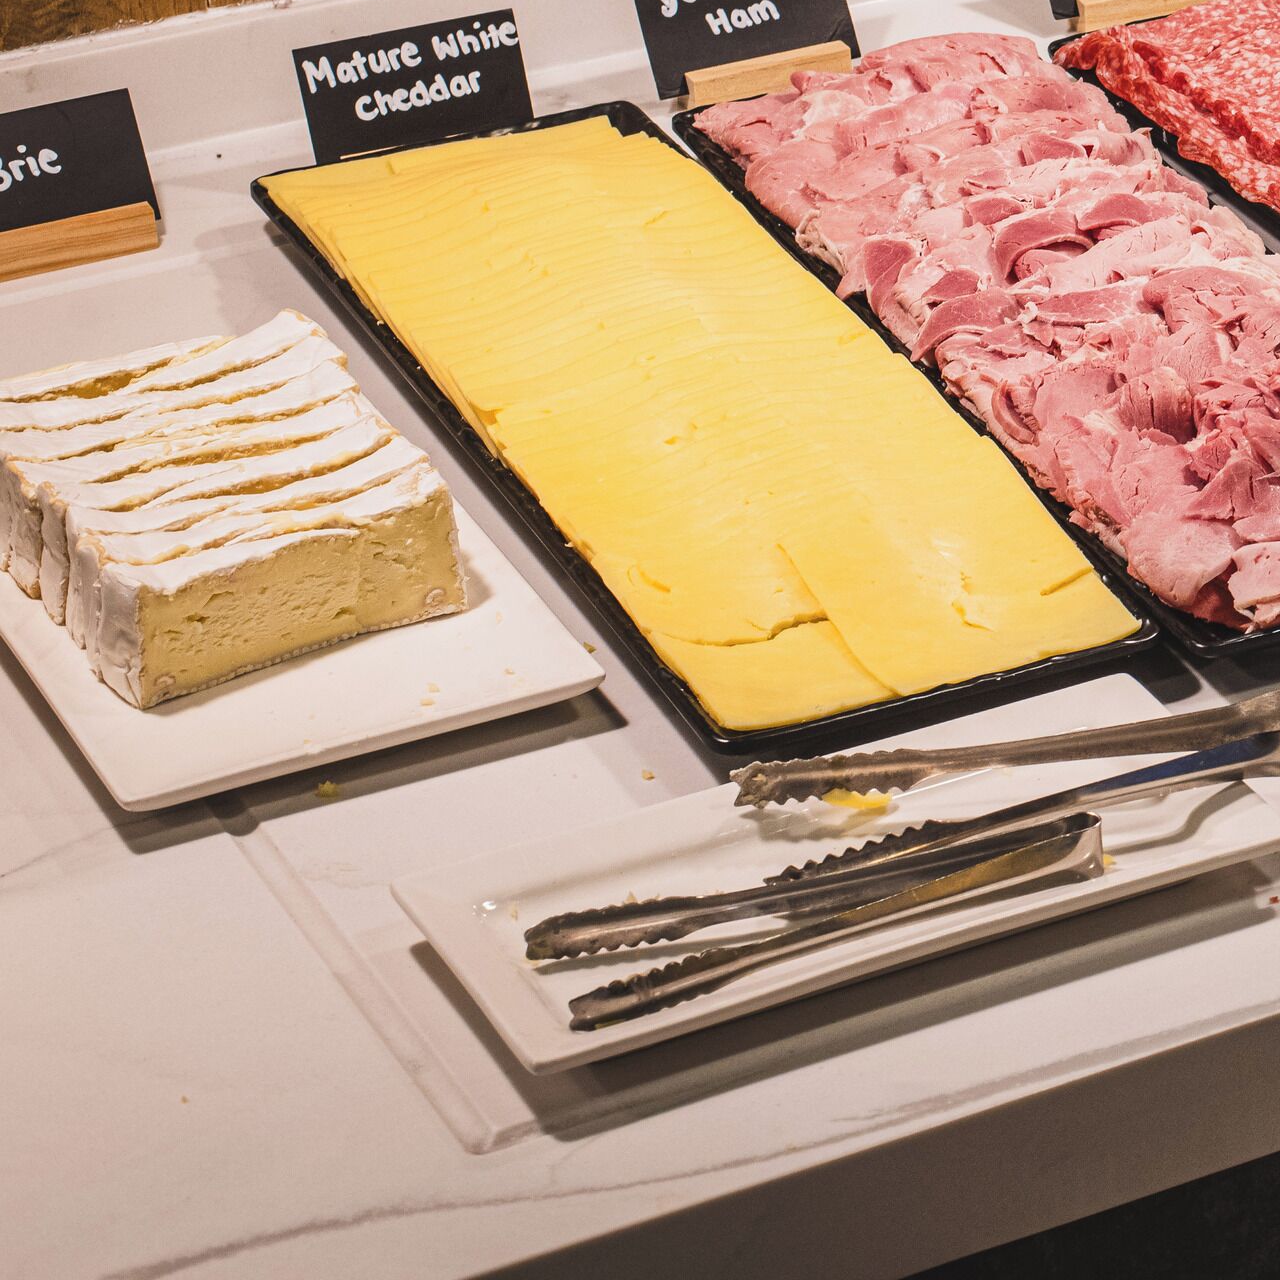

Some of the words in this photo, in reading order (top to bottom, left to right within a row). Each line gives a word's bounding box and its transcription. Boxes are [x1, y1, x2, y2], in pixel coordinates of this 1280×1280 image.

[705, 0, 781, 36] Ham
[302, 41, 422, 95] Mature
[432, 21, 519, 61] White
[354, 70, 482, 121] Cheddar
